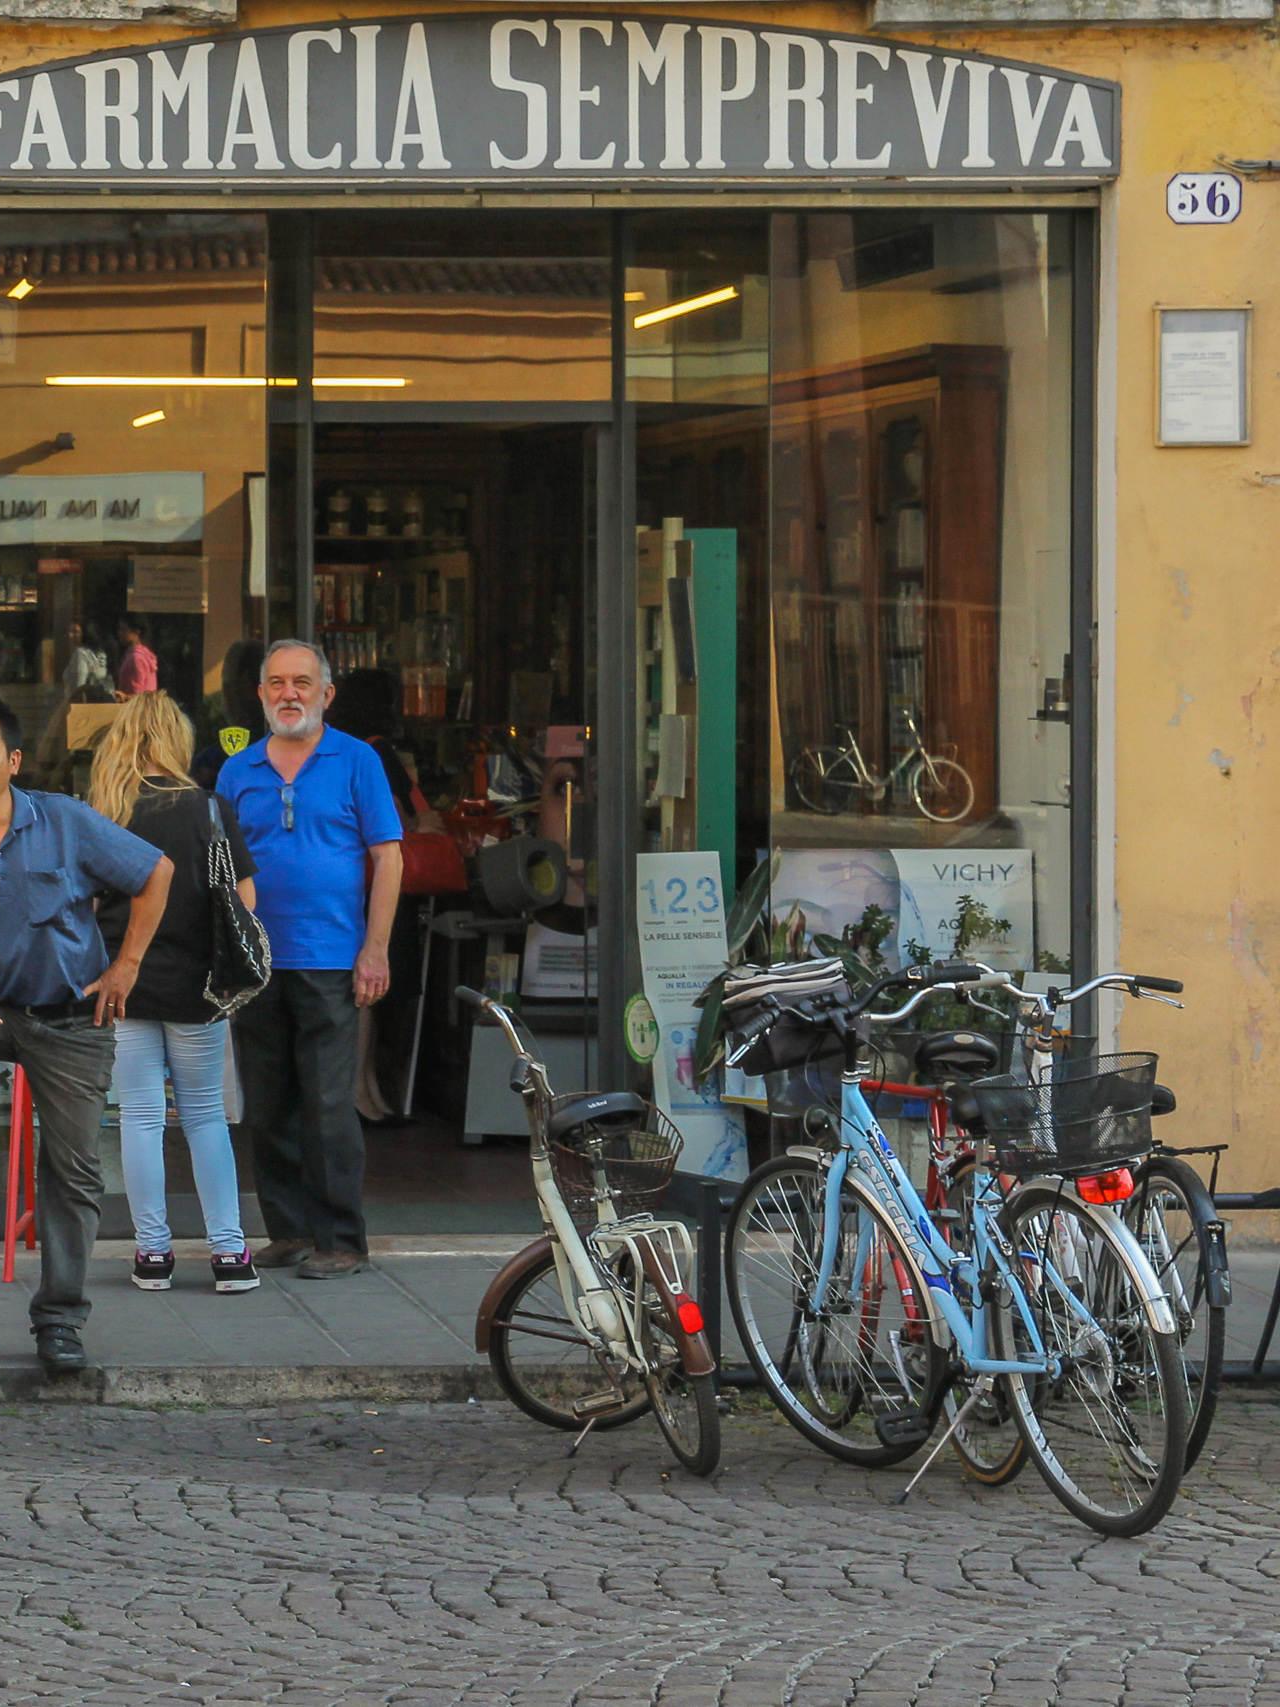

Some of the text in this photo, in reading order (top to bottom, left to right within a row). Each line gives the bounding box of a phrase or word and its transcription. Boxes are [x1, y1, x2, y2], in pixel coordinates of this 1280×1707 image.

[488, 17, 1113, 171] SEMPREVIVA
[1177, 179, 1234, 220] 56
[932, 863, 1014, 882] VICHY
[644, 931, 722, 941] LA PELLE SENSIBILE
[658, 972, 687, 980] AQUALIA
[676, 981, 709, 989] REGALO
